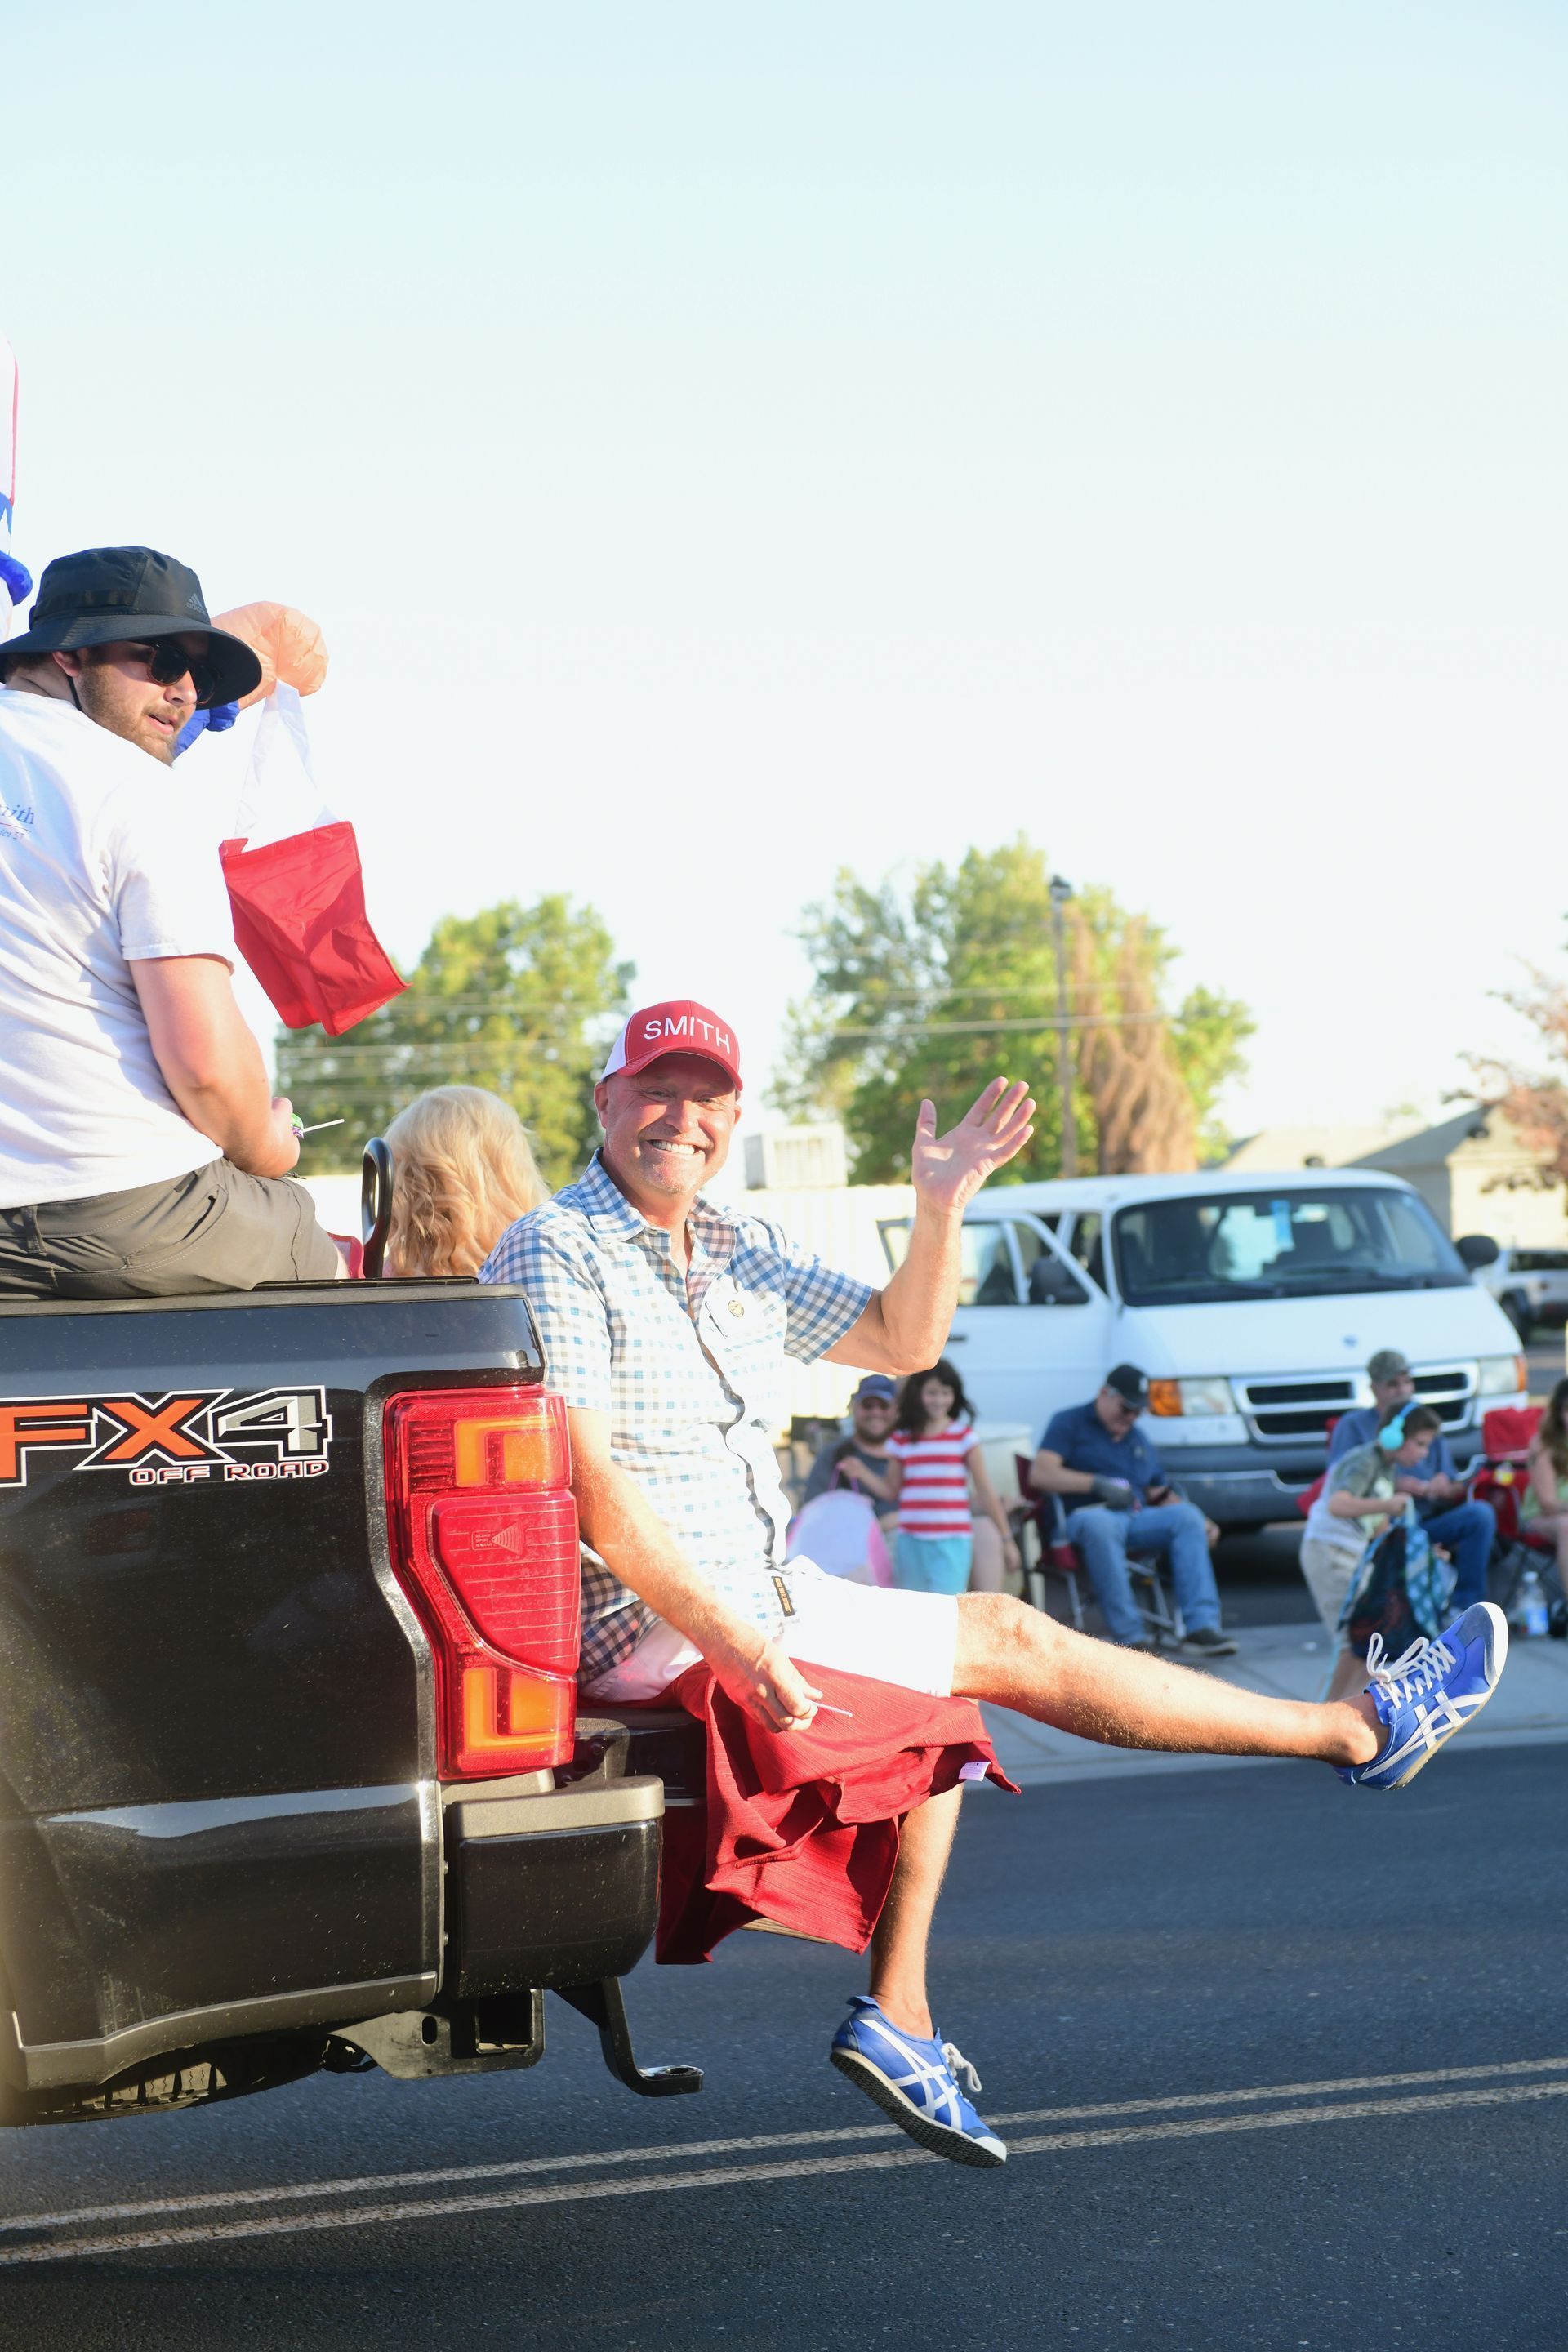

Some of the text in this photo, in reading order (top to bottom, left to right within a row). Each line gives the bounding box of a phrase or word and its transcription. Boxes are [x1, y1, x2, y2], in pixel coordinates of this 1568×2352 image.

[644, 1015, 730, 1054] SMITH
[0, 1386, 331, 1486] FX4
[129, 1460, 328, 1486] OFF ROAD
